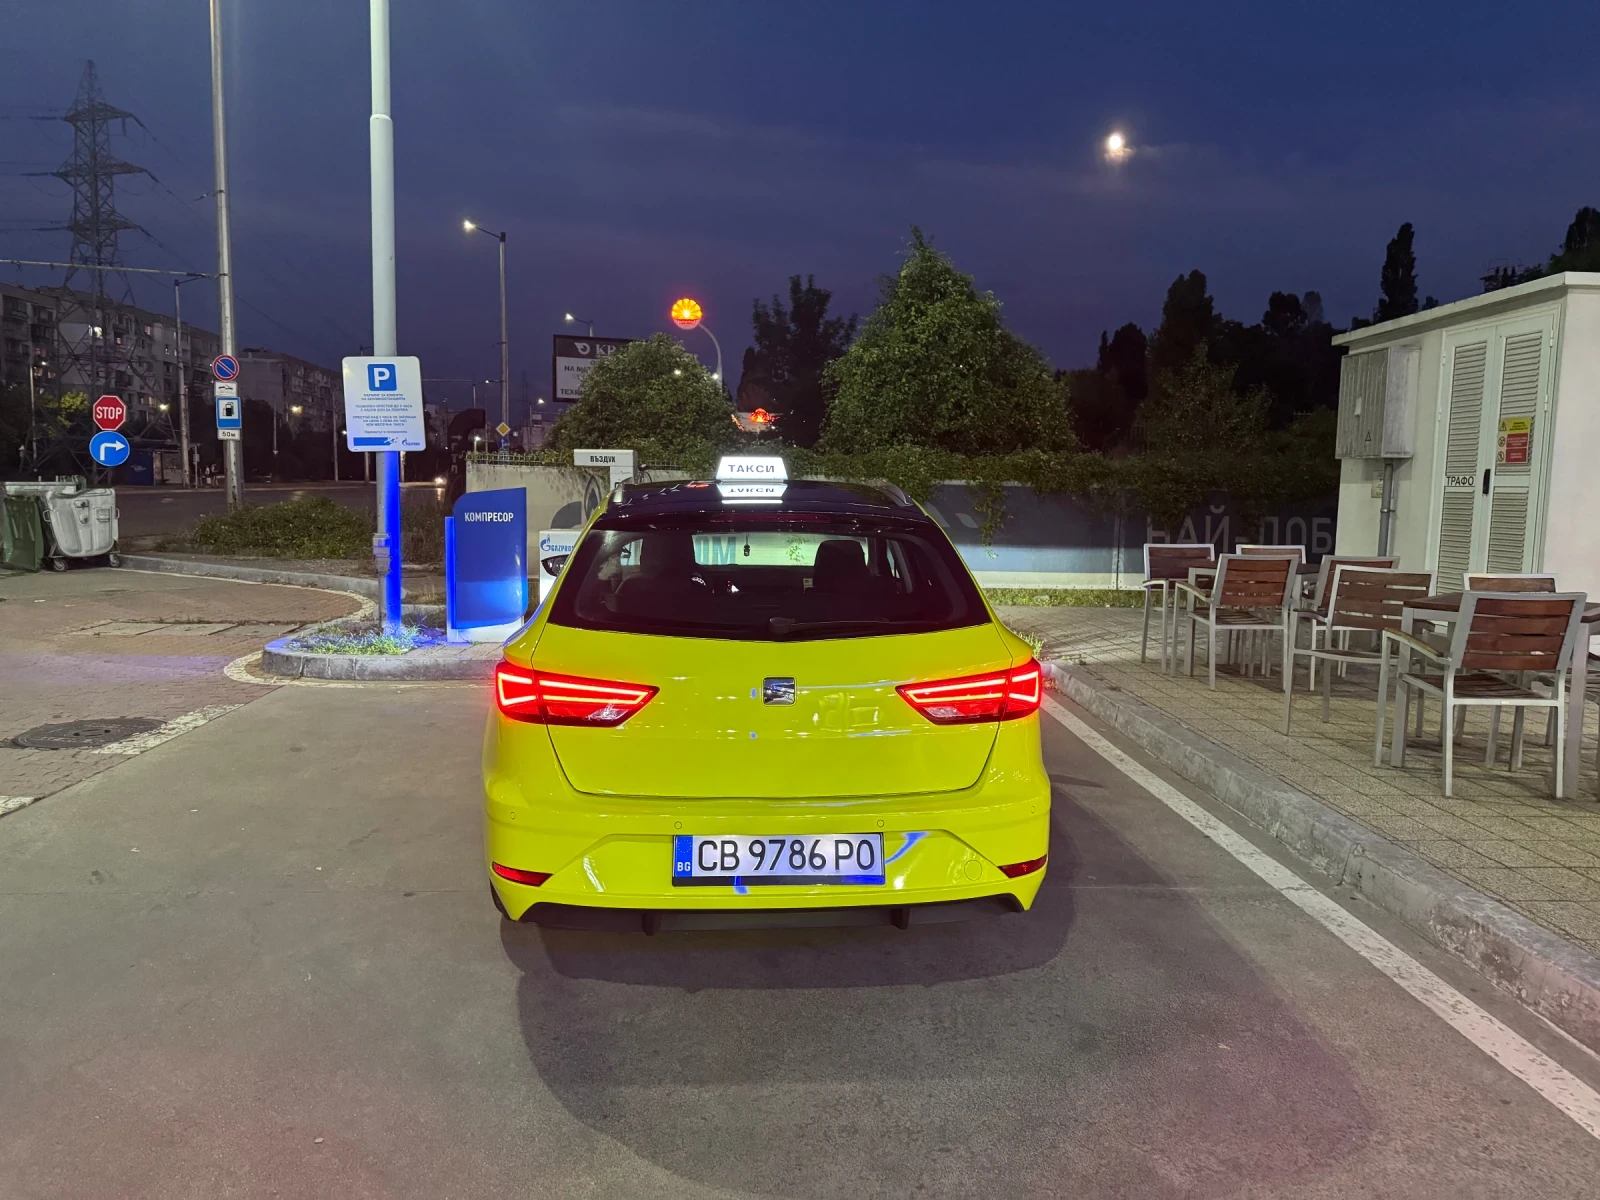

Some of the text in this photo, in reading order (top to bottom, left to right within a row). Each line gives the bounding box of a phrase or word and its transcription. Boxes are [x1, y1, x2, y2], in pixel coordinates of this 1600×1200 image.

[373, 367, 390, 388] P
[96, 406, 123, 420] STOP
[728, 464, 775, 473] ТАКСИ
[1446, 476, 1475, 486] ТРАФО
[464, 512, 514, 522] КОМПРЕСОР
[677, 861, 691, 872] BG
[698, 839, 740, 872] CB
[748, 839, 827, 871] 9786
